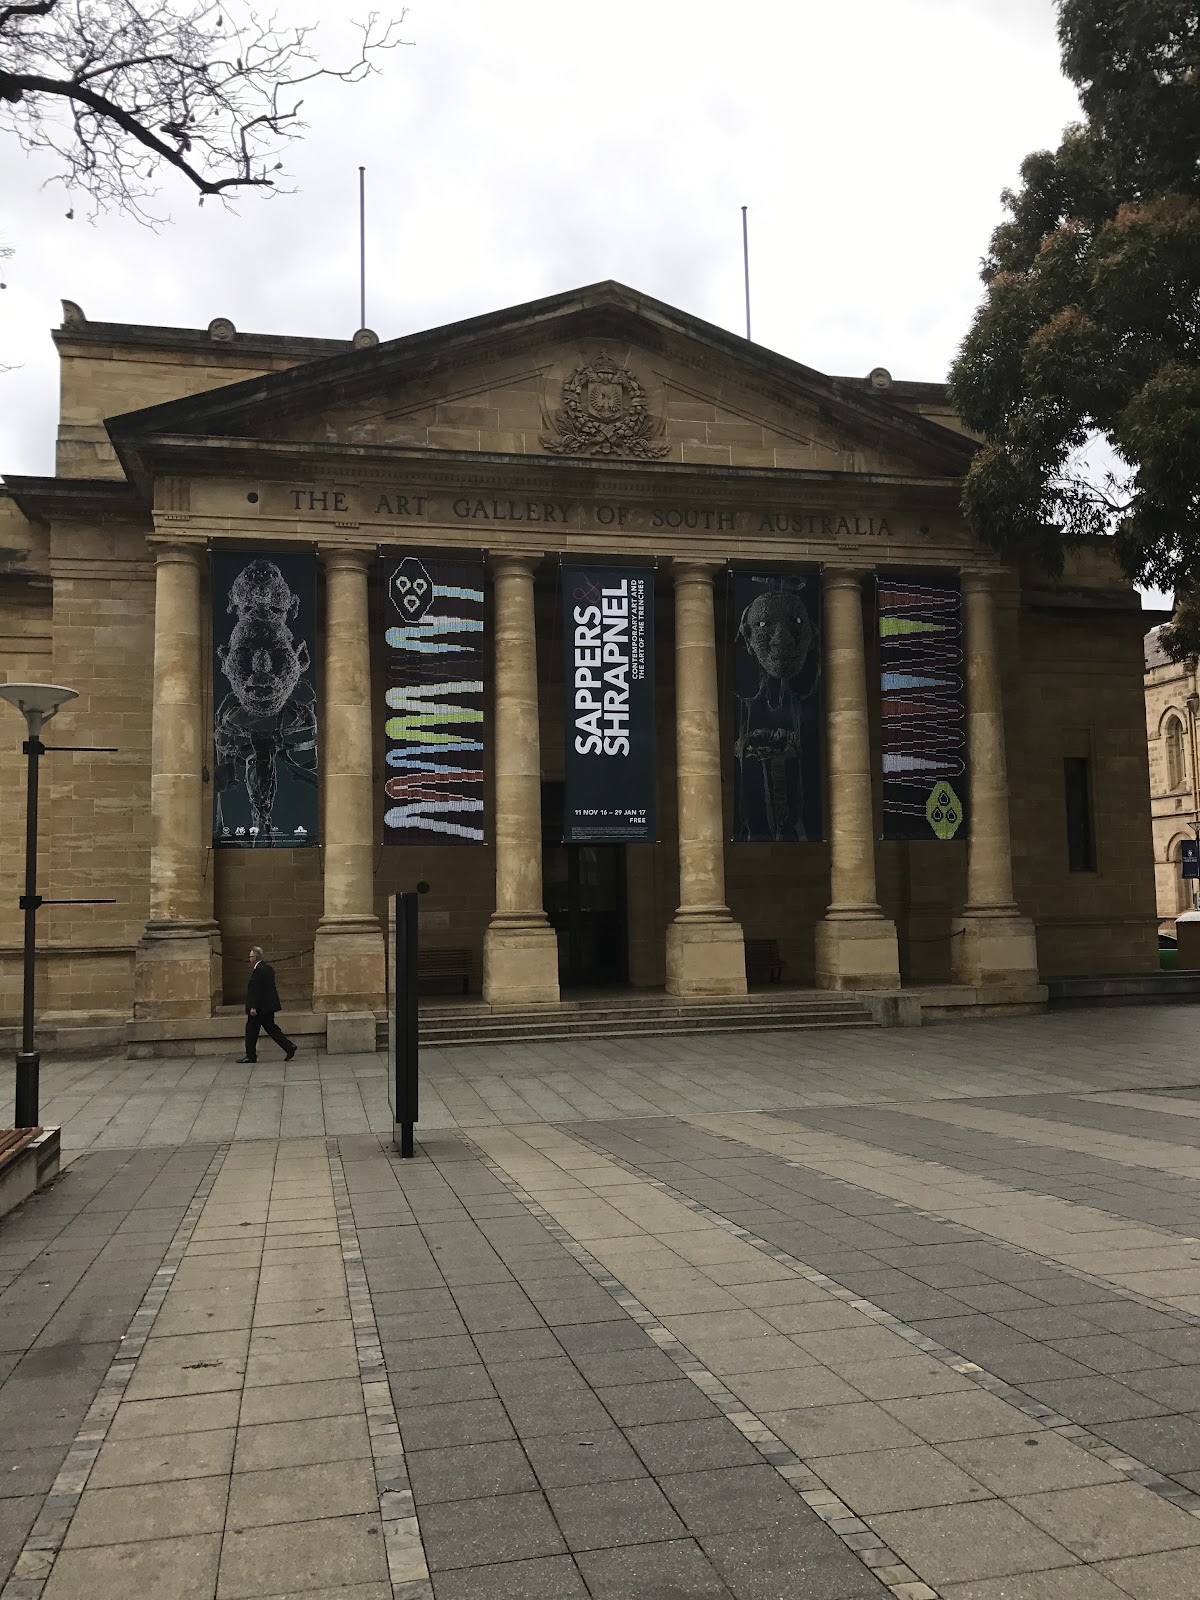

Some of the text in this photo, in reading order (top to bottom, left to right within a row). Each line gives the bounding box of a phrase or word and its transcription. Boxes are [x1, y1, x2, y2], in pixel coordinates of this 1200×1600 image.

[290, 490, 893, 536] THE ART GALLERY OF SOUTH AUSTRALIA
[602, 579, 630, 757] SHRAPNEL
[631, 615, 639, 680] CONTEMPORARY
[638, 637, 645, 649] OF
[573, 605, 602, 756] SAPPERS
